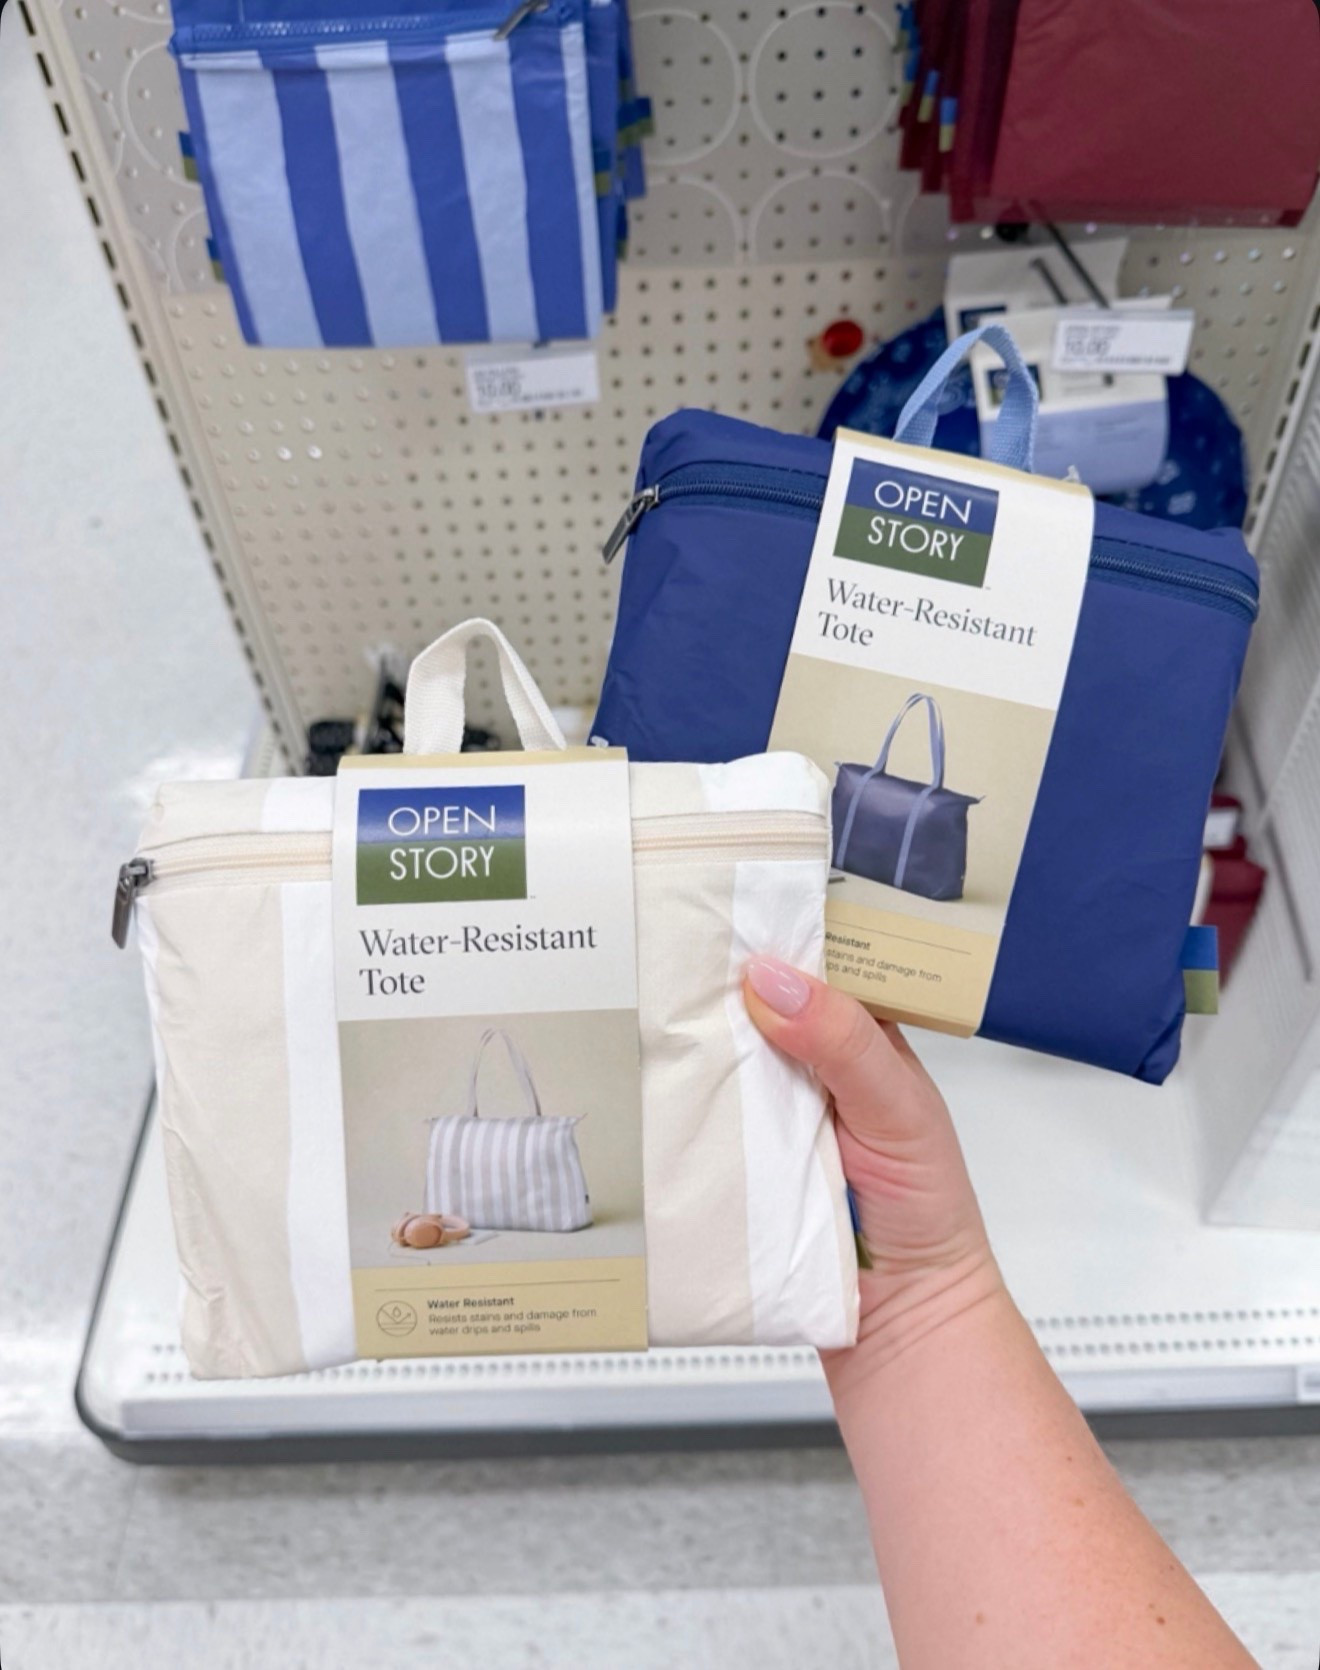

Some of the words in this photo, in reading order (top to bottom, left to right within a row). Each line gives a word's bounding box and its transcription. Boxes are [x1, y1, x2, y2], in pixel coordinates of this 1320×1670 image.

[874, 480, 972, 524] OPEN
[867, 516, 965, 560] STORY
[818, 611, 874, 646] Tote
[827, 577, 1038, 647] Water-Resistant
[388, 805, 496, 836] OPEN
[390, 846, 495, 881] STORY
[359, 924, 598, 957] Water-Resistant
[359, 968, 426, 996] Tote
[826, 948, 855, 962] stains
[856, 956, 876, 967] and
[876, 960, 917, 977] damage
[919, 969, 942, 983] from
[841, 965, 860, 977] and
[862, 969, 887, 983] spills
[427, 1299, 460, 1309] Water
[463, 1297, 514, 1307] Resistant
[429, 1313, 468, 1324] Resists
[469, 1312, 501, 1322] stains
[503, 1311, 524, 1321] and
[526, 1309, 569, 1321] damage
[572, 1308, 597, 1318] from
[429, 1325, 459, 1335] water
[461, 1324, 489, 1336] drips
[491, 1323, 511, 1333] and
[513, 1322, 541, 1334] spills
